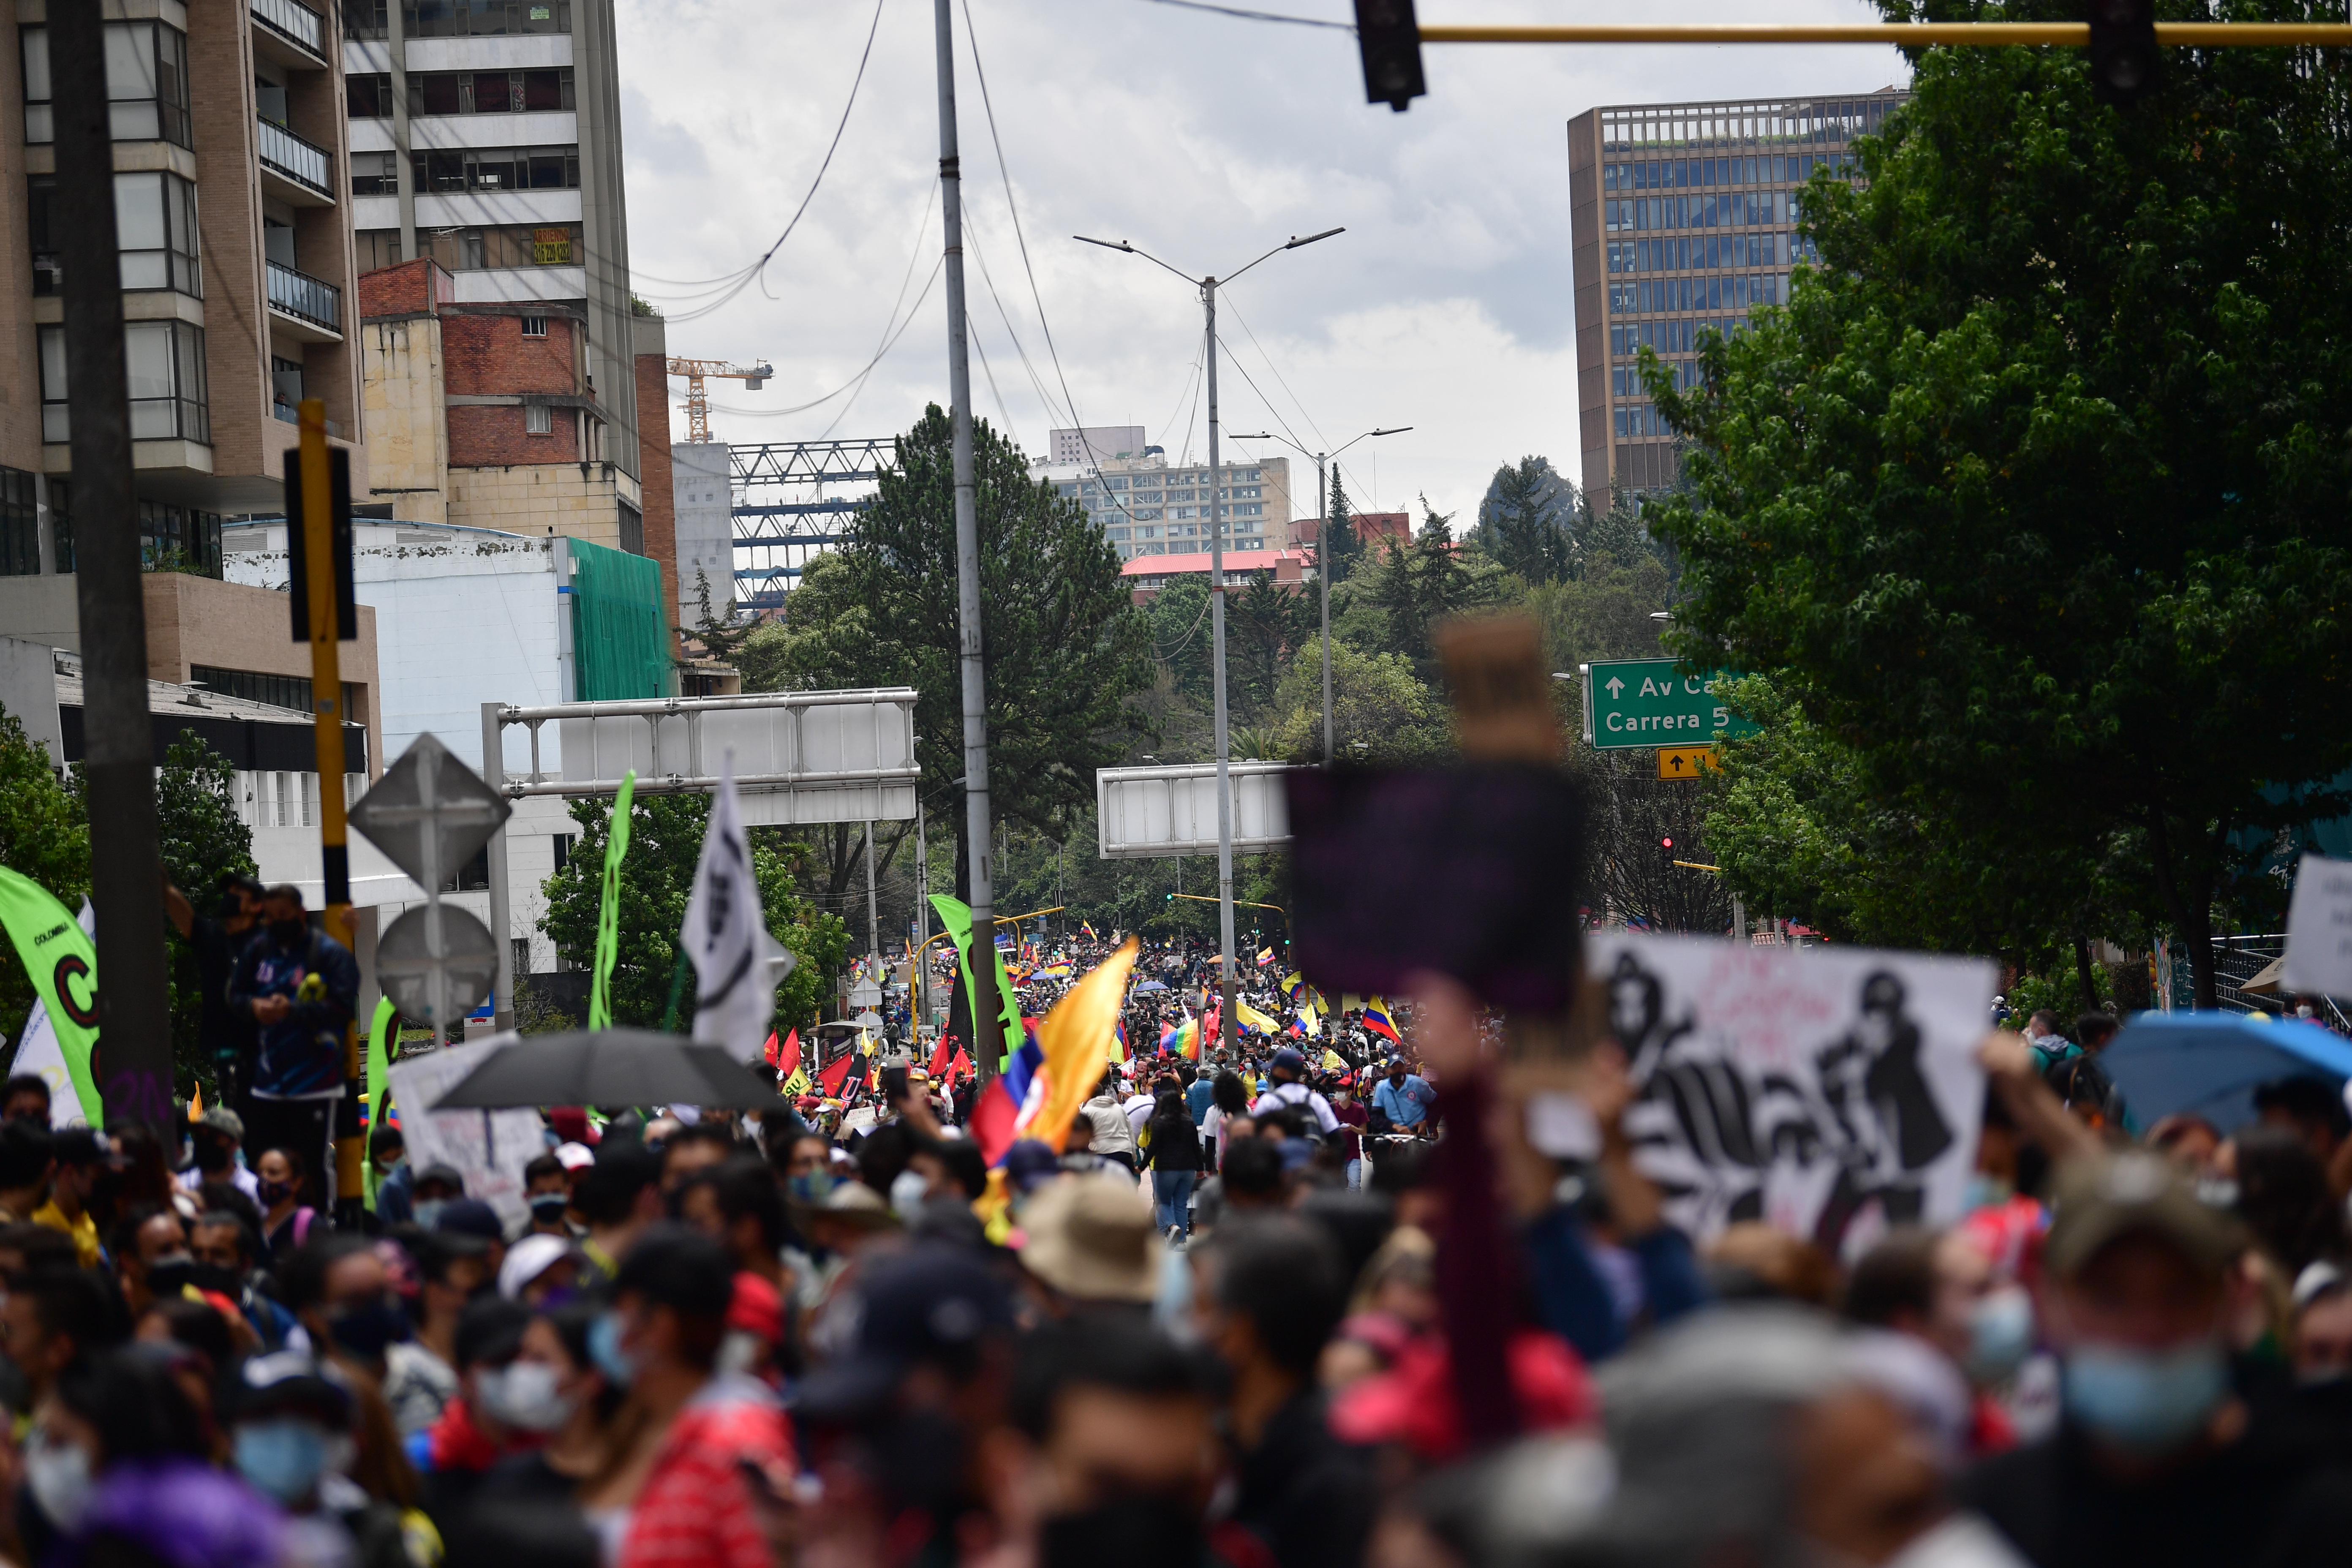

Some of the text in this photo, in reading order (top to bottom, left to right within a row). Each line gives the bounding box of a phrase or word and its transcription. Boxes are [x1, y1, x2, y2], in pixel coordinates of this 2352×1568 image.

[534, 229, 568, 242] ARRIENDO
[535, 243, 570, 262] 316 220 1282
[1639, 675, 1731, 697] Av Ca
[1606, 706, 1729, 732] Carrera 5
